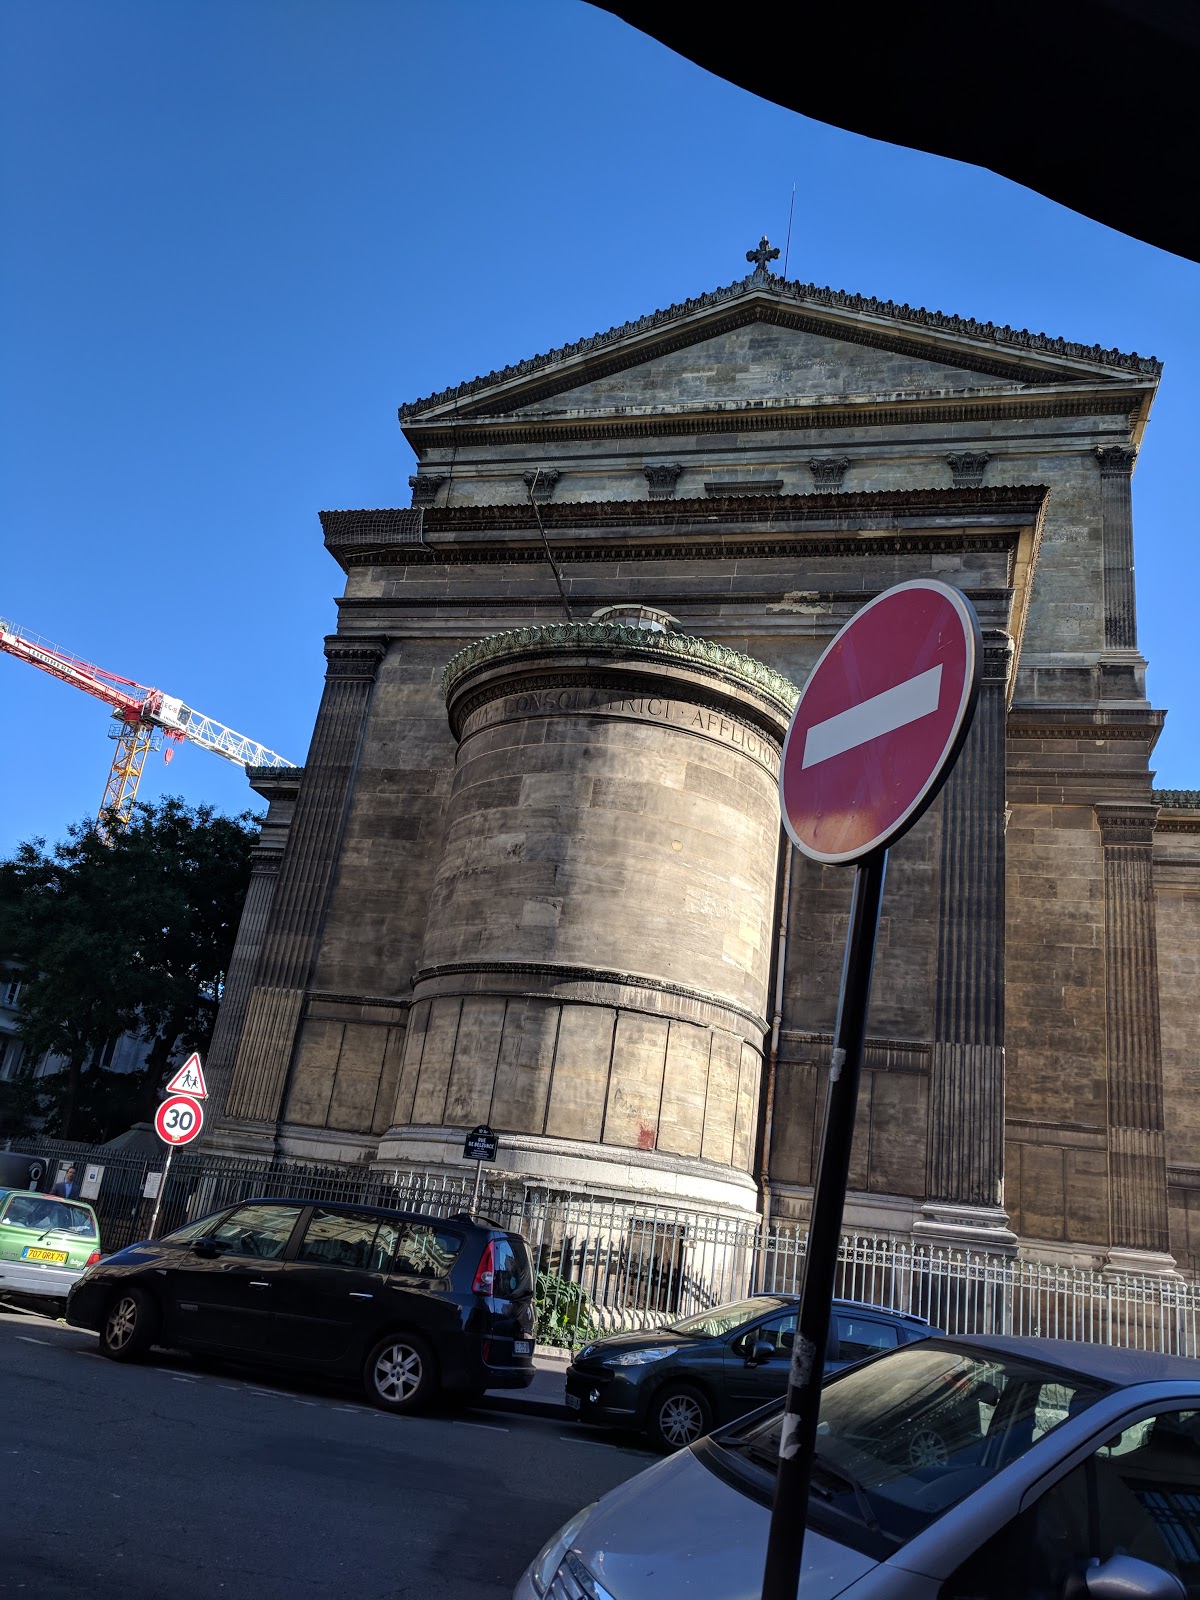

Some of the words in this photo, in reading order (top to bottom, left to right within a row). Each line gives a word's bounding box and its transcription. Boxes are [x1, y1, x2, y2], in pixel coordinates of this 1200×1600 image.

[166, 1108, 193, 1131] 30
[29, 1249, 42, 1259] 707
[55, 1252, 65, 1261] 75
